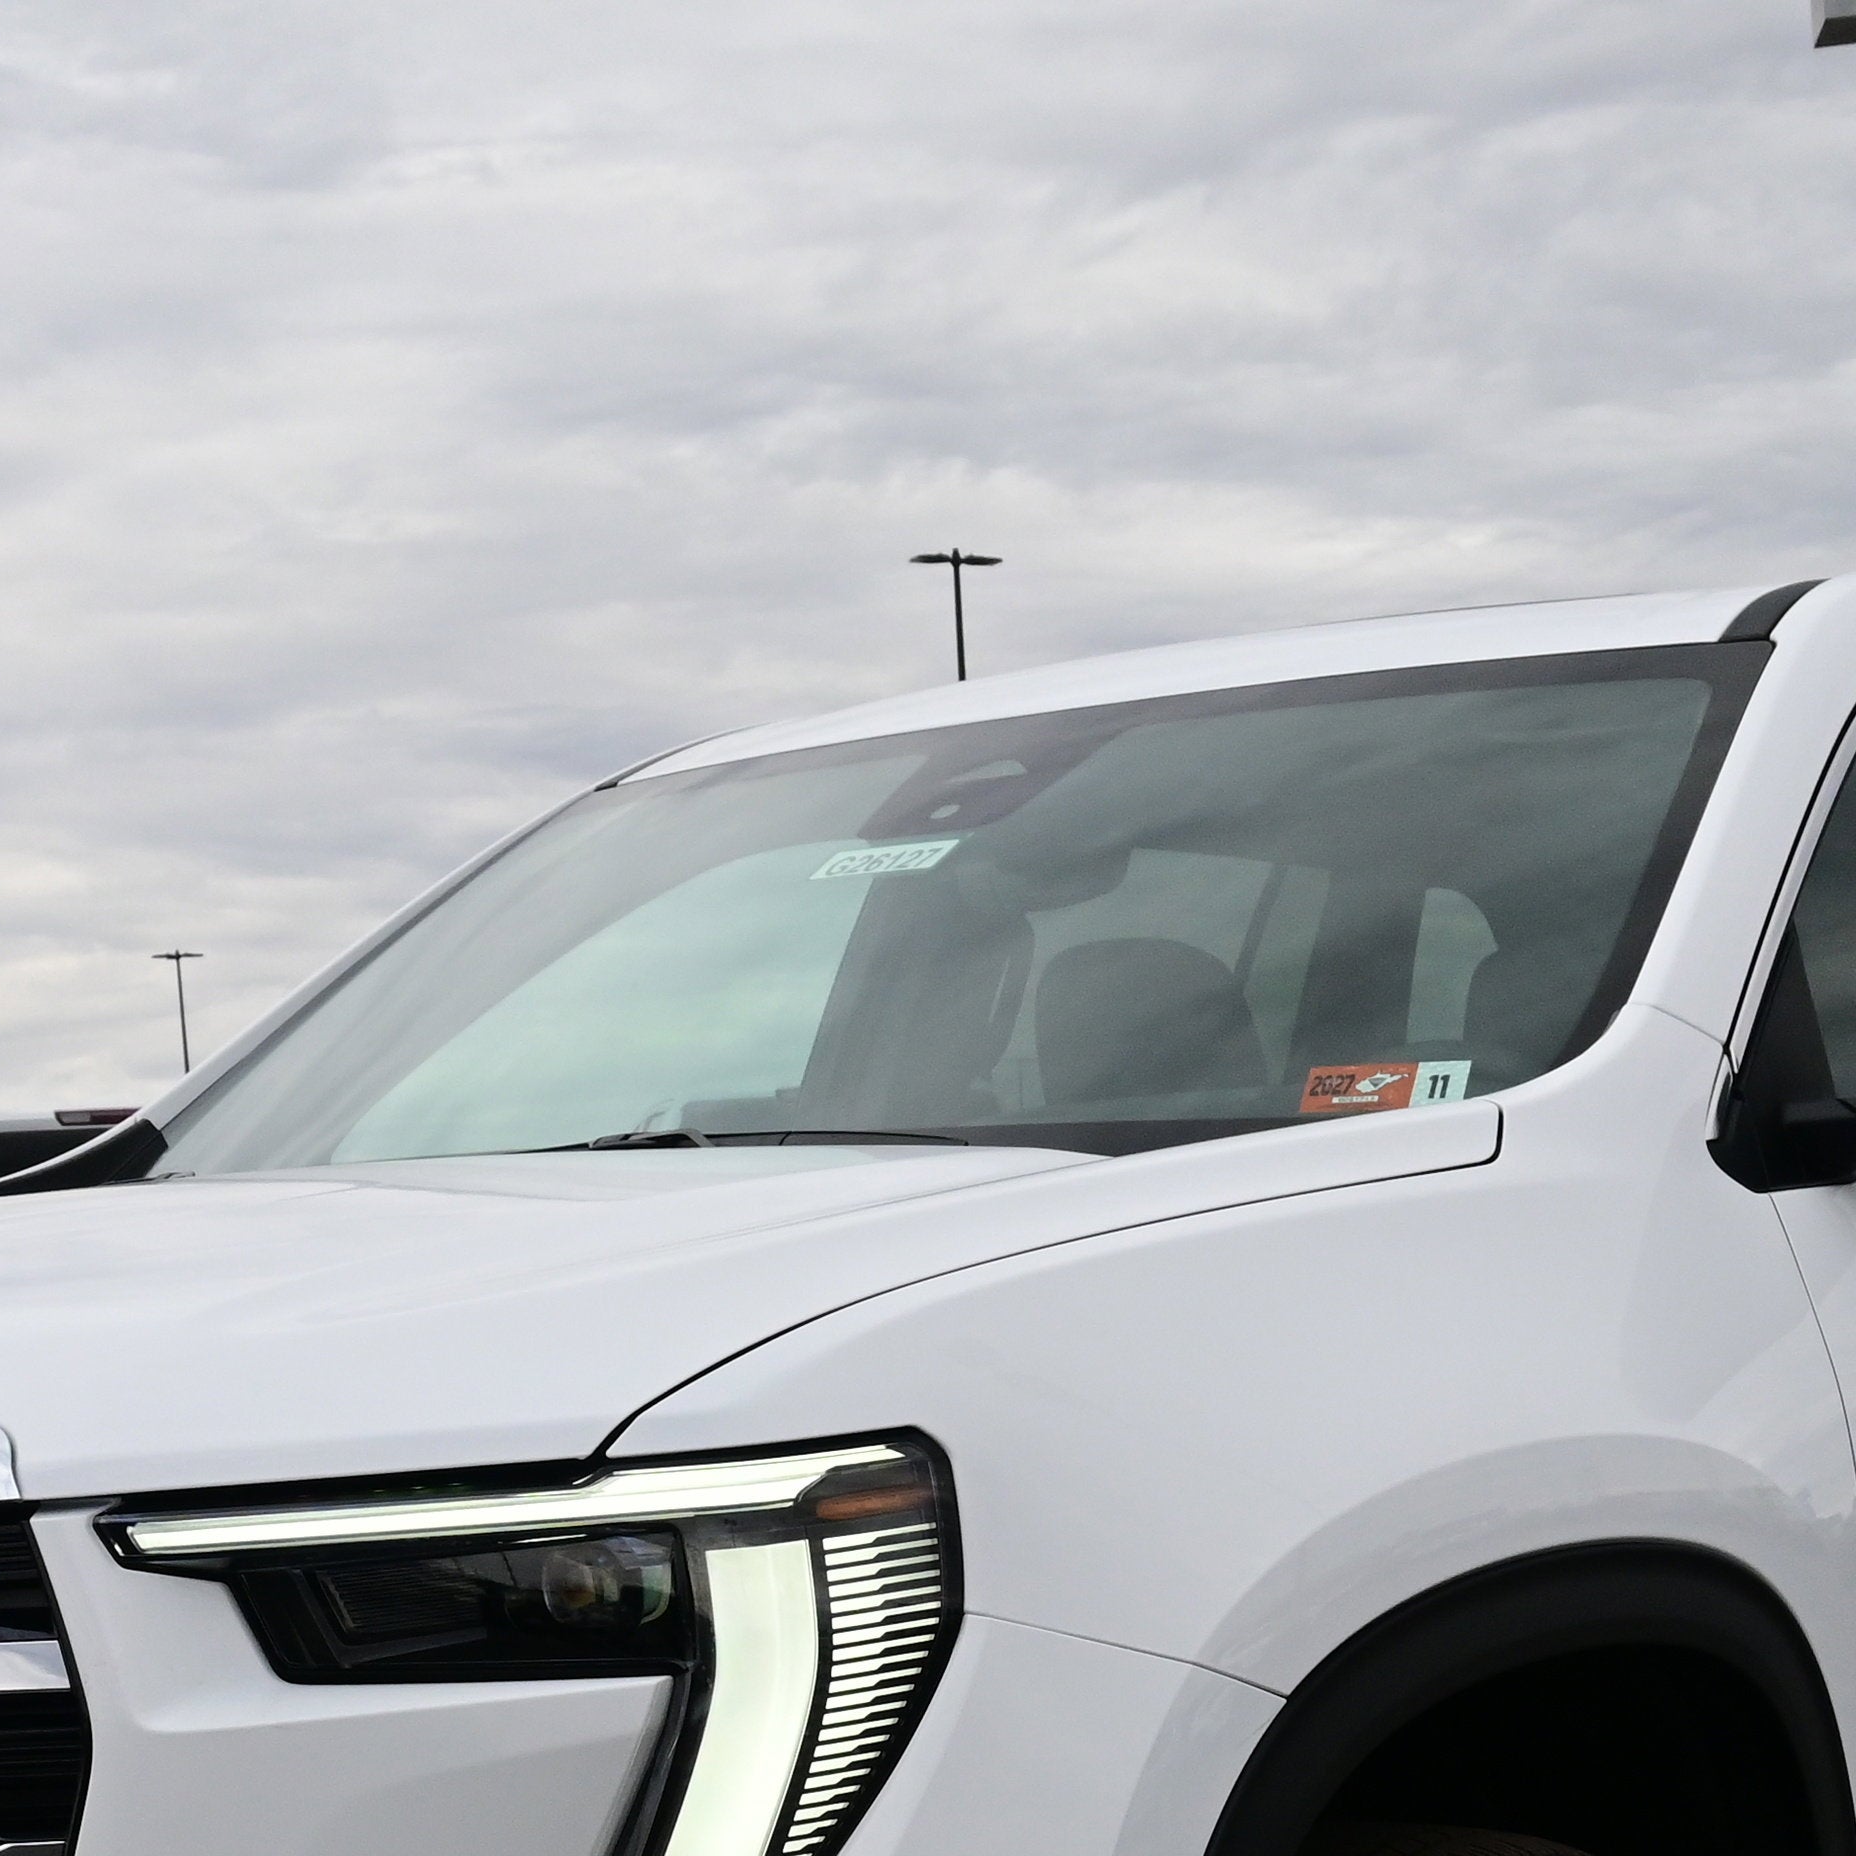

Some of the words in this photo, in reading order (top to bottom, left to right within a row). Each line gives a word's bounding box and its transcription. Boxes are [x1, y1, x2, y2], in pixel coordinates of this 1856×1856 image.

[825, 846, 945, 877] G26127
[1308, 1073, 1356, 1097] 2027
[1427, 1073, 1452, 1100] 11
